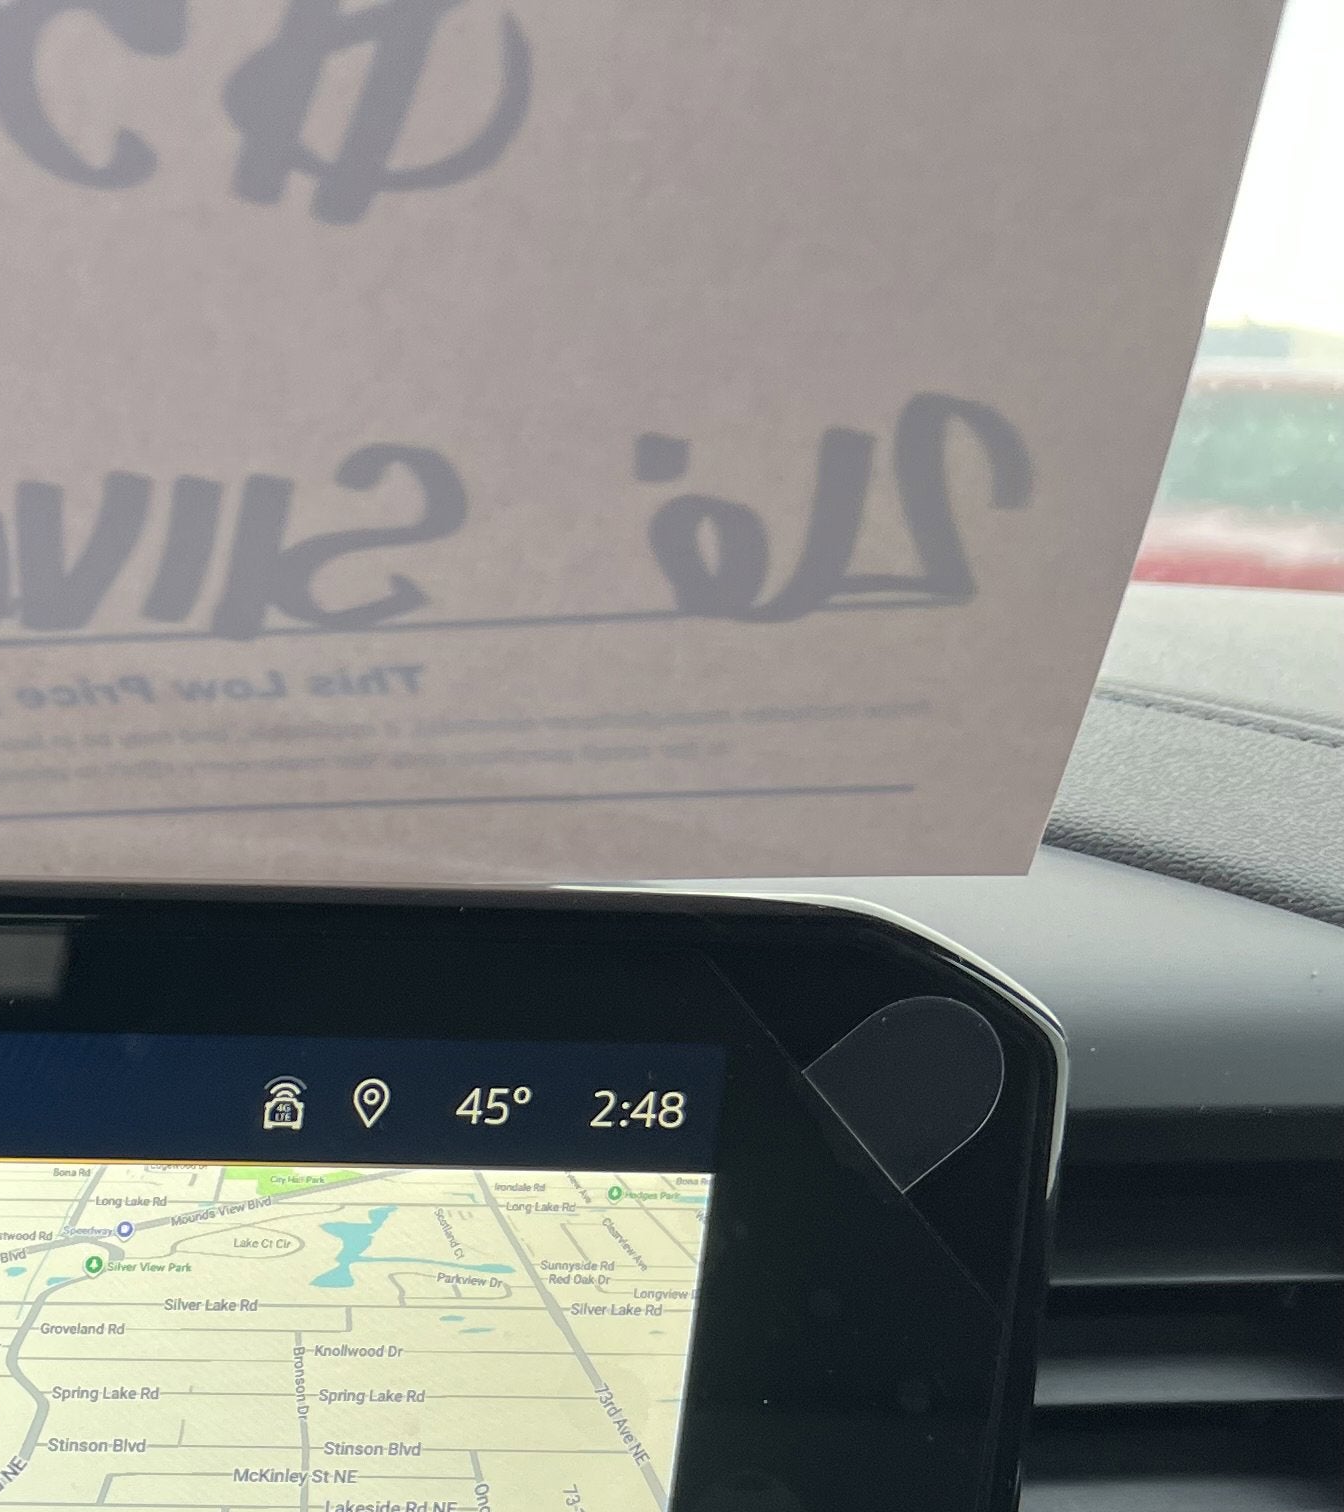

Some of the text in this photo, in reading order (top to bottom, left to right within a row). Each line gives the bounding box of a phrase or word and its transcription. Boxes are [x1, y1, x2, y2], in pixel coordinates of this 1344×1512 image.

[455, 1086, 532, 1125] 45°
[590, 1090, 686, 1128] 2:48
[78, 1168, 91, 1177] Rd
[533, 1183, 546, 1192] Rd
[96, 1196, 167, 1208] Long Lake Rd
[506, 1202, 576, 1214] Long Lake Rd
[171, 1209, 216, 1226] Mounds
[217, 1202, 246, 1216] View
[38, 1230, 53, 1241] Rd
[233, 1238, 259, 1248] Lake
[0, 1247, 27, 1264] Blvd
[107, 1262, 192, 1272] Silver View Park
[540, 1260, 615, 1273] Sunnyside Rd
[633, 1255, 648, 1272] Ave
[437, 1272, 503, 1289] Parkview Dr
[548, 1275, 610, 1285] Red Oak Dr
[633, 1288, 688, 1300] Longview
[164, 1299, 258, 1312] Silver Lake Rd
[570, 1303, 663, 1316] Silver Lake Rd
[40, 1322, 125, 1335] Groveland Rd
[314, 1344, 403, 1358] Knollwood Dr
[293, 1346, 309, 1420] Bronson Dr
[52, 1386, 160, 1403] Spring Lake Rd
[318, 1388, 426, 1405] Spring Lake Rd
[595, 1383, 651, 1467] 73rd Ave NE
[47, 1438, 146, 1452] Stinson Blvd
[324, 1441, 421, 1456] Stinson Blvd
[0, 1455, 28, 1483] NE
[233, 1469, 357, 1486] McKinley St NE
